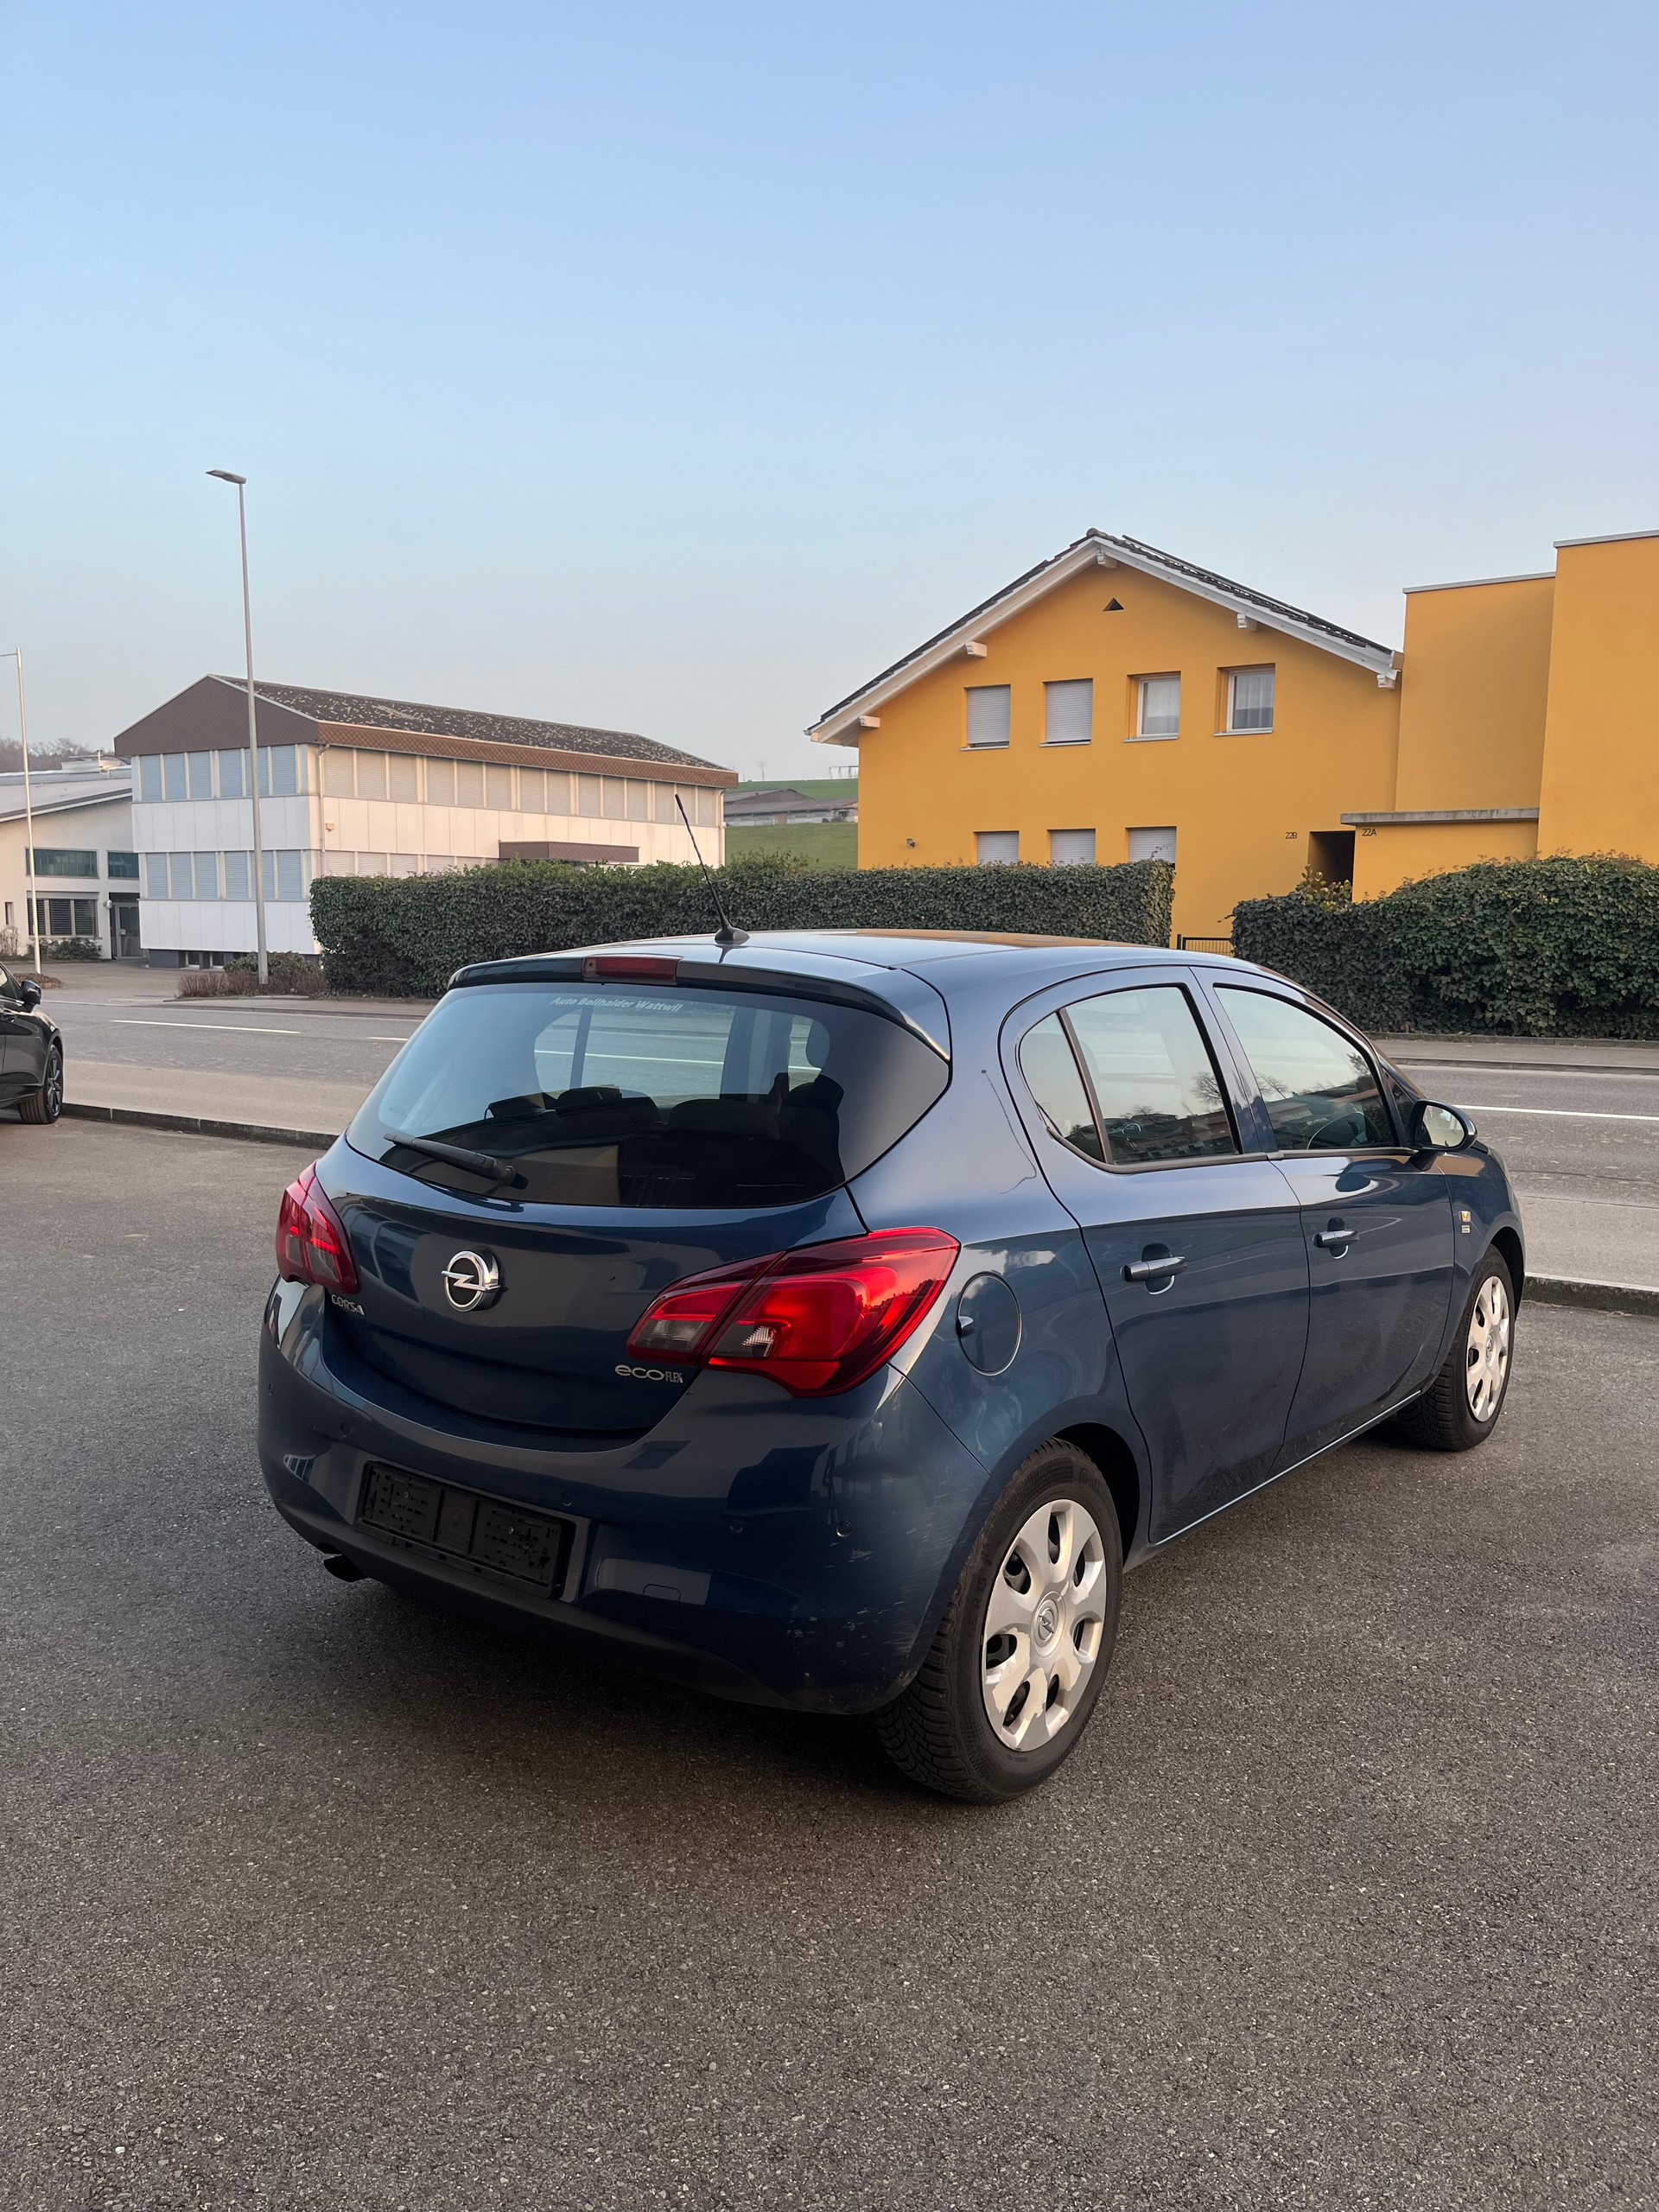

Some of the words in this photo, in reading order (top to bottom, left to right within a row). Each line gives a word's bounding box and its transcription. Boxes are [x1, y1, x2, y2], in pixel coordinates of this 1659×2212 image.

[1362, 828, 1377, 836] 22A
[550, 996, 578, 1006] Auto
[576, 997, 636, 1008] Bollhalder
[634, 1000, 683, 1012] Wattwil
[331, 1294, 365, 1316] CORSA
